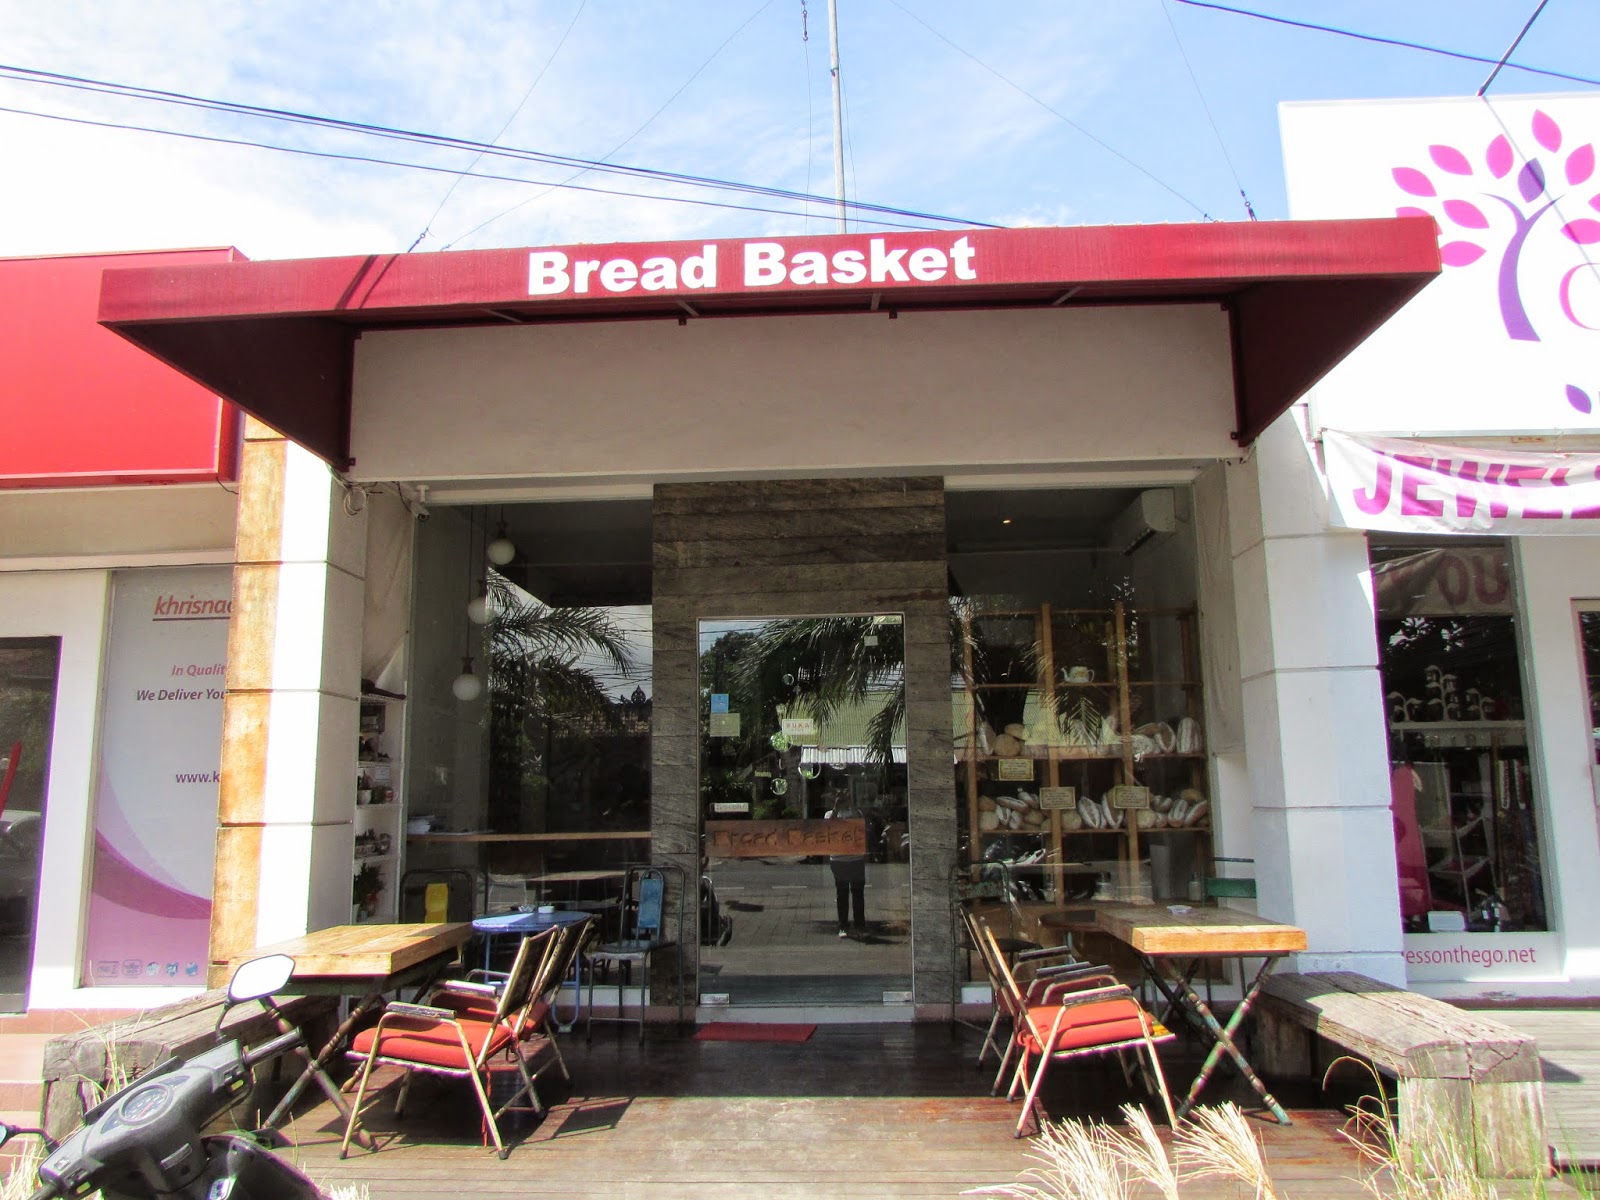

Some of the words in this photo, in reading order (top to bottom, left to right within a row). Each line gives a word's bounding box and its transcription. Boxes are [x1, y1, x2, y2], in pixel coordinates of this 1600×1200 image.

[528, 244, 717, 295] Bread
[743, 235, 977, 287] Basket
[171, 664, 184, 676] In
[136, 688, 156, 701] We
[158, 688, 203, 701] Deliver
[175, 770, 220, 784] www.k
[1406, 945, 1537, 968] essonthego.net
